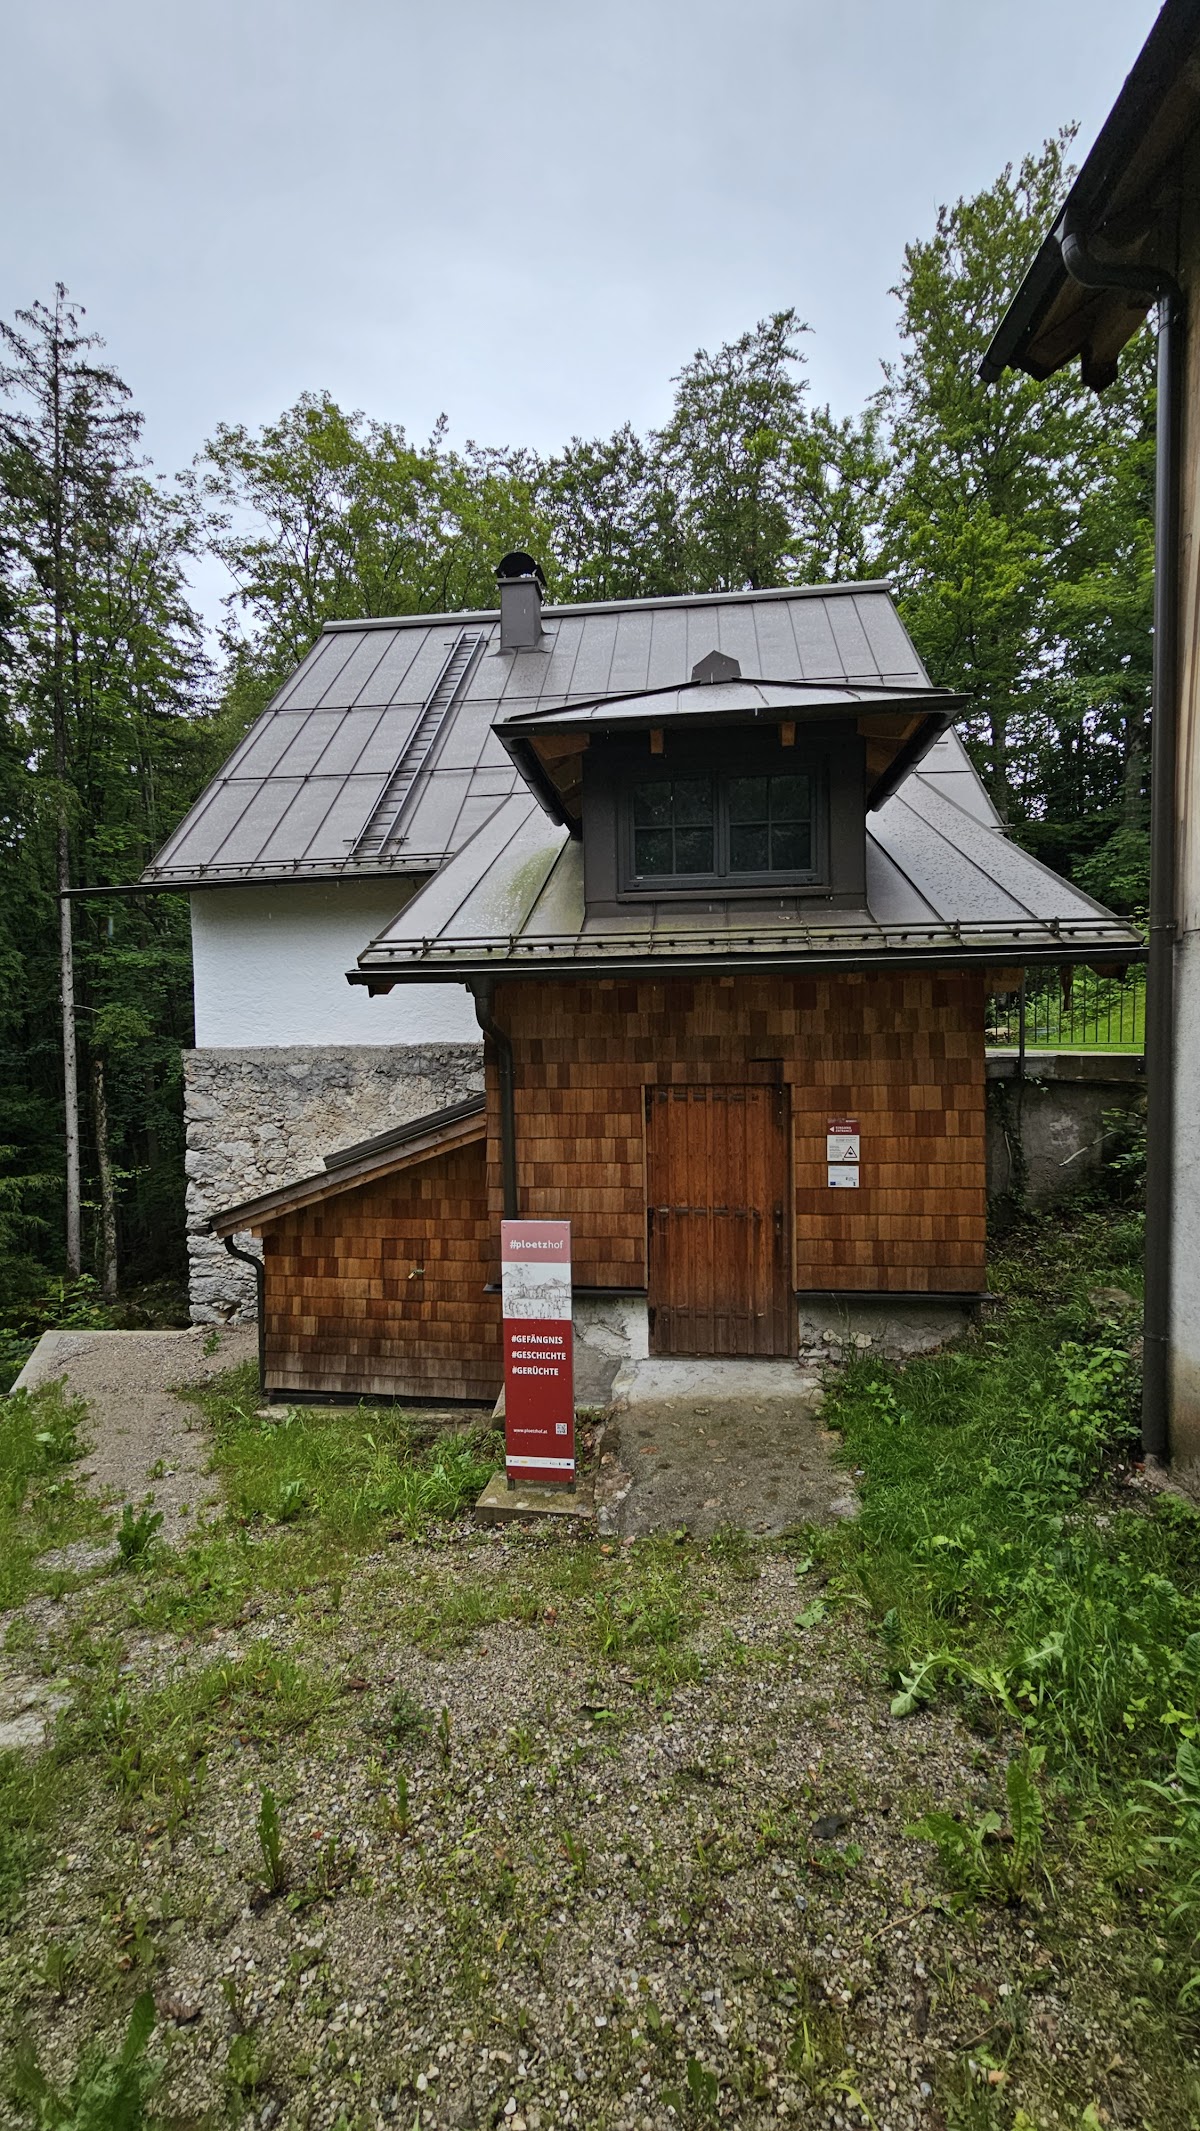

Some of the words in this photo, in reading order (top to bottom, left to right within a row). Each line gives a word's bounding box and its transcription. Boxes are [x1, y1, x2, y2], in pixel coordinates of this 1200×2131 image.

[510, 1240, 564, 1250] #ploetzhof
[511, 1334, 563, 1344] #GEFÄNGNIS
[511, 1351, 567, 1360] #GESCHICHTE
[512, 1365, 559, 1376] #GERÜCHTE
